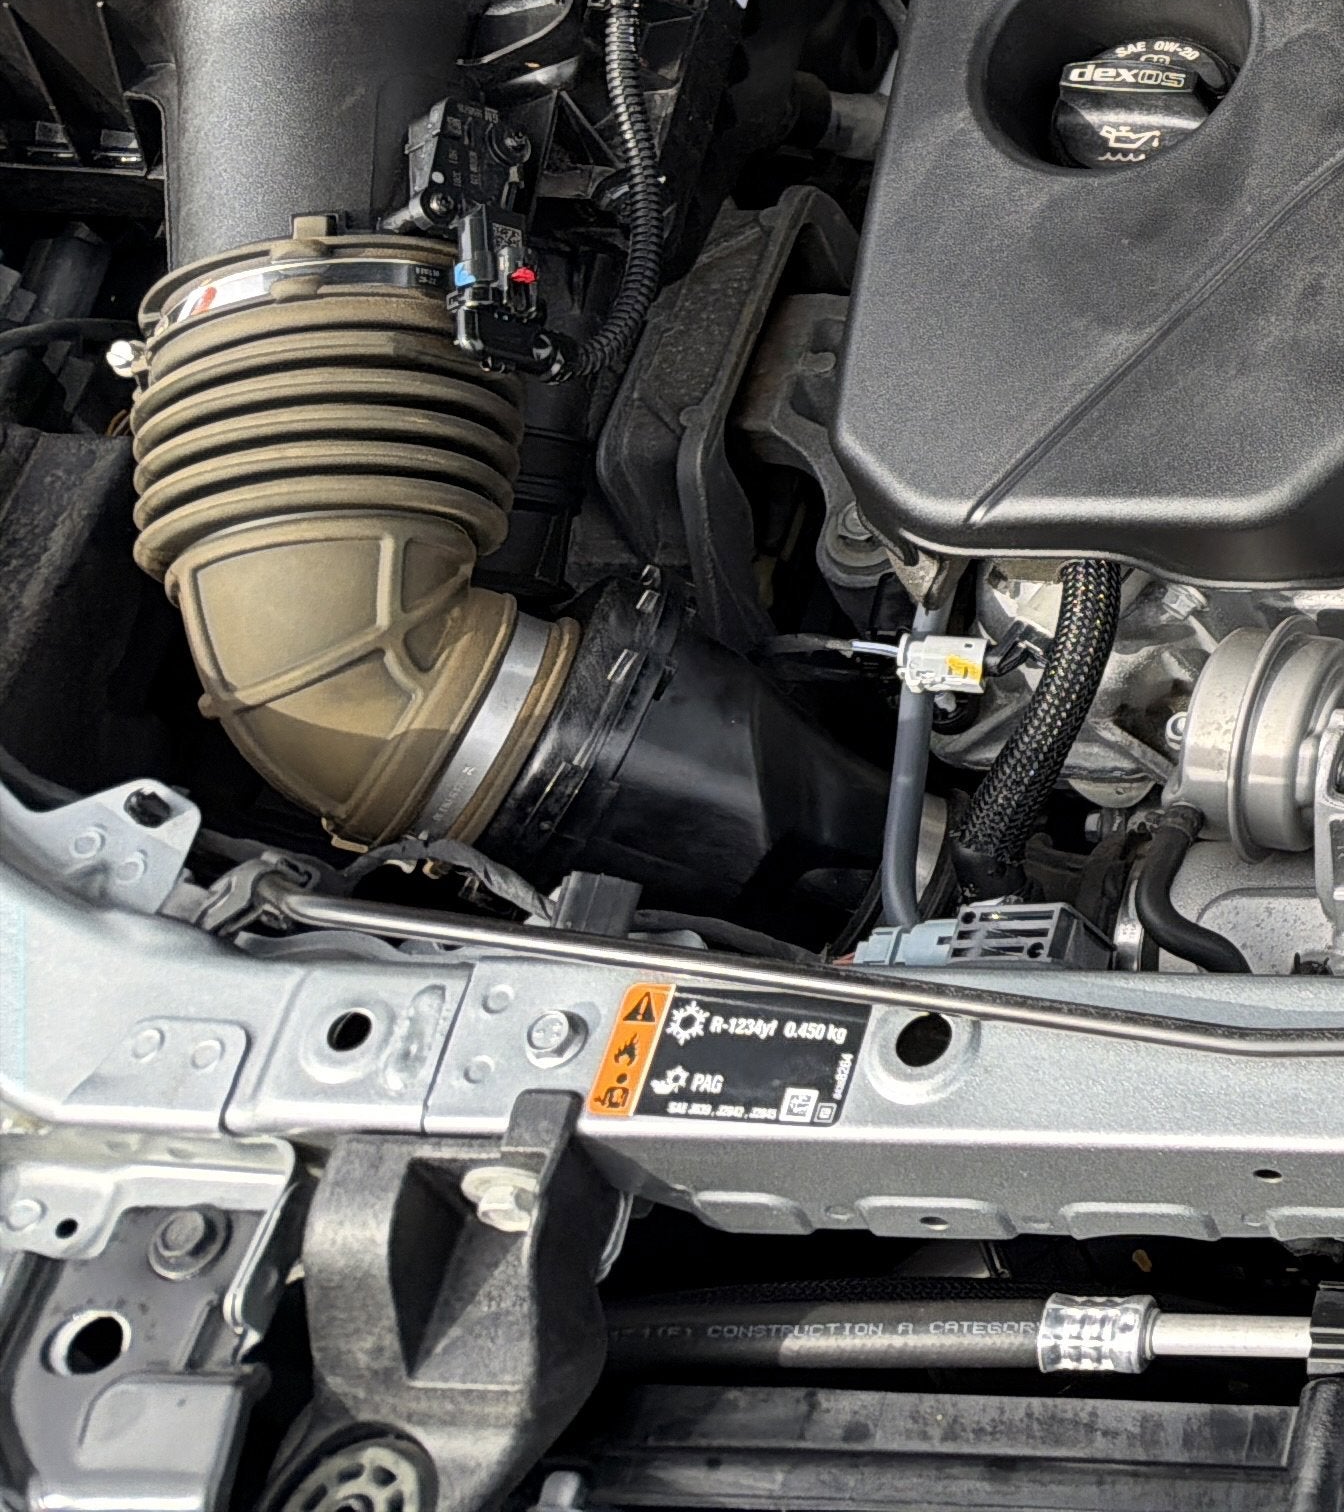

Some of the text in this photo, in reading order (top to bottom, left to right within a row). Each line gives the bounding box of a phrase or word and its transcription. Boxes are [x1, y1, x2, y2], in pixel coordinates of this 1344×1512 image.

[1115, 40, 1200, 61] SAE 0W-20
[1069, 64, 1186, 88] dexos
[709, 1016, 848, 1045] R-1234yf 0.450 kg
[691, 1072, 724, 1095] PAG
[706, 1322, 885, 1339] CONSTRUCTION
